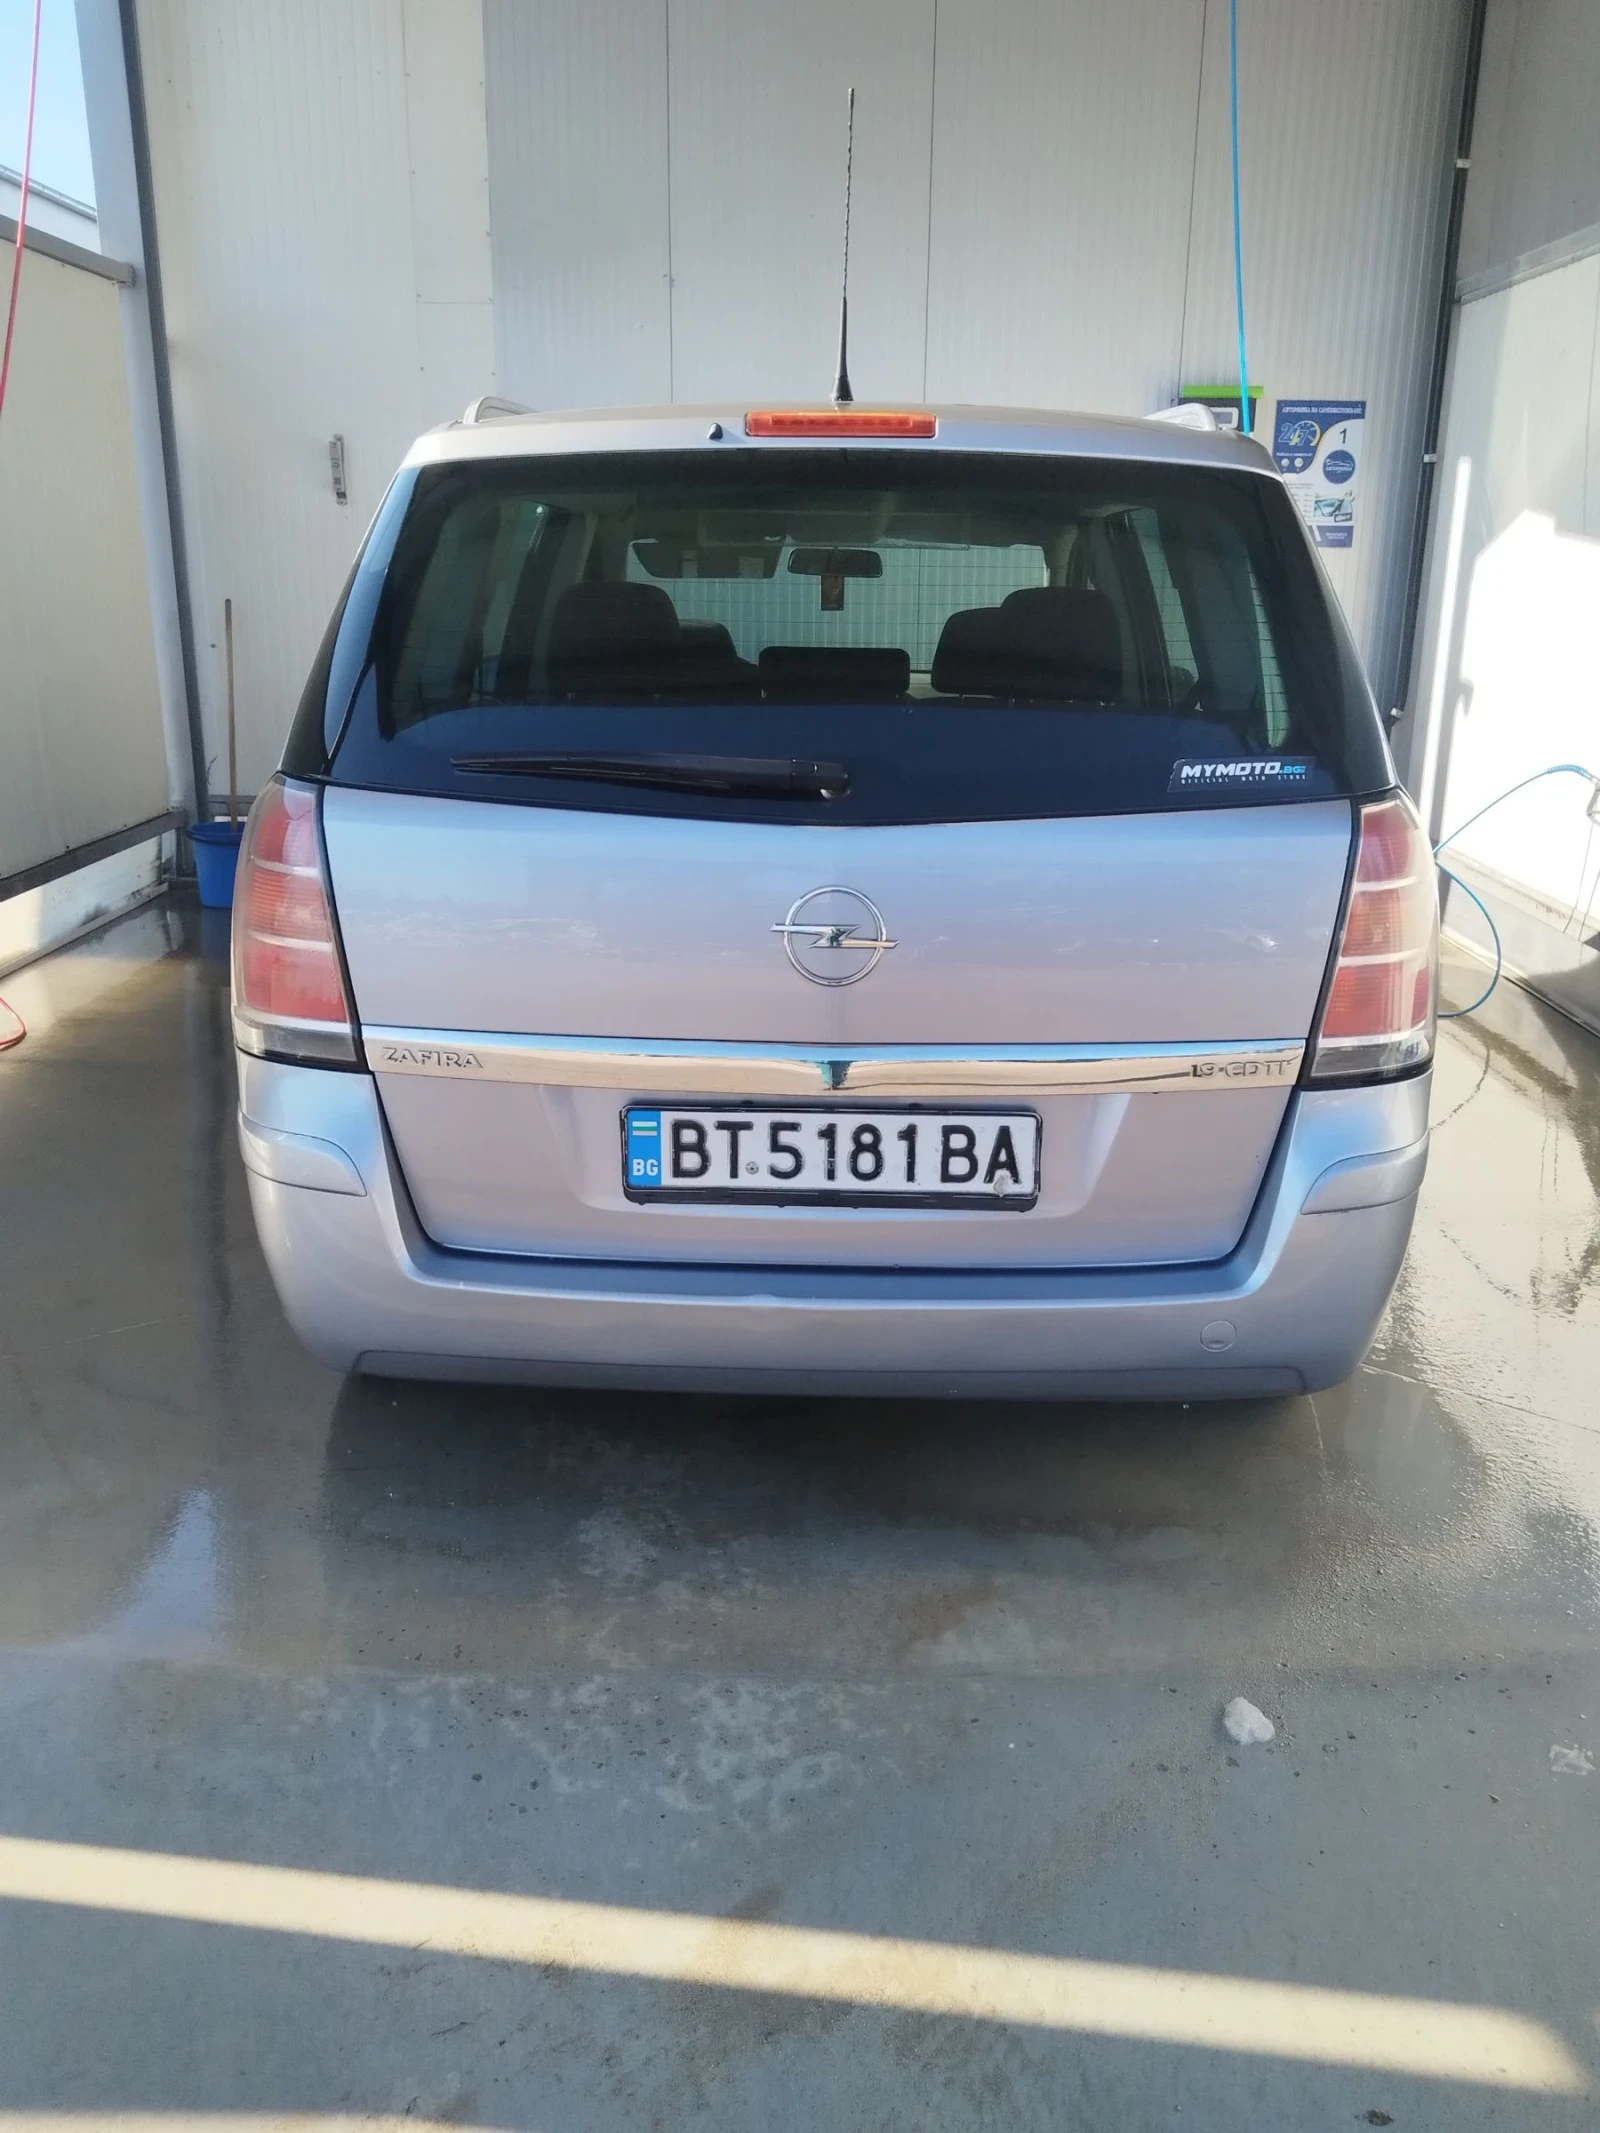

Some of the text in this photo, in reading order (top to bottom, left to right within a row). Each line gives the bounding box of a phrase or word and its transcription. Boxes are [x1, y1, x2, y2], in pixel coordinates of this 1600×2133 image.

[1339, 428, 1348, 445] 1
[382, 1046, 484, 1069] ZAFIRA
[632, 1158, 659, 1177] BG
